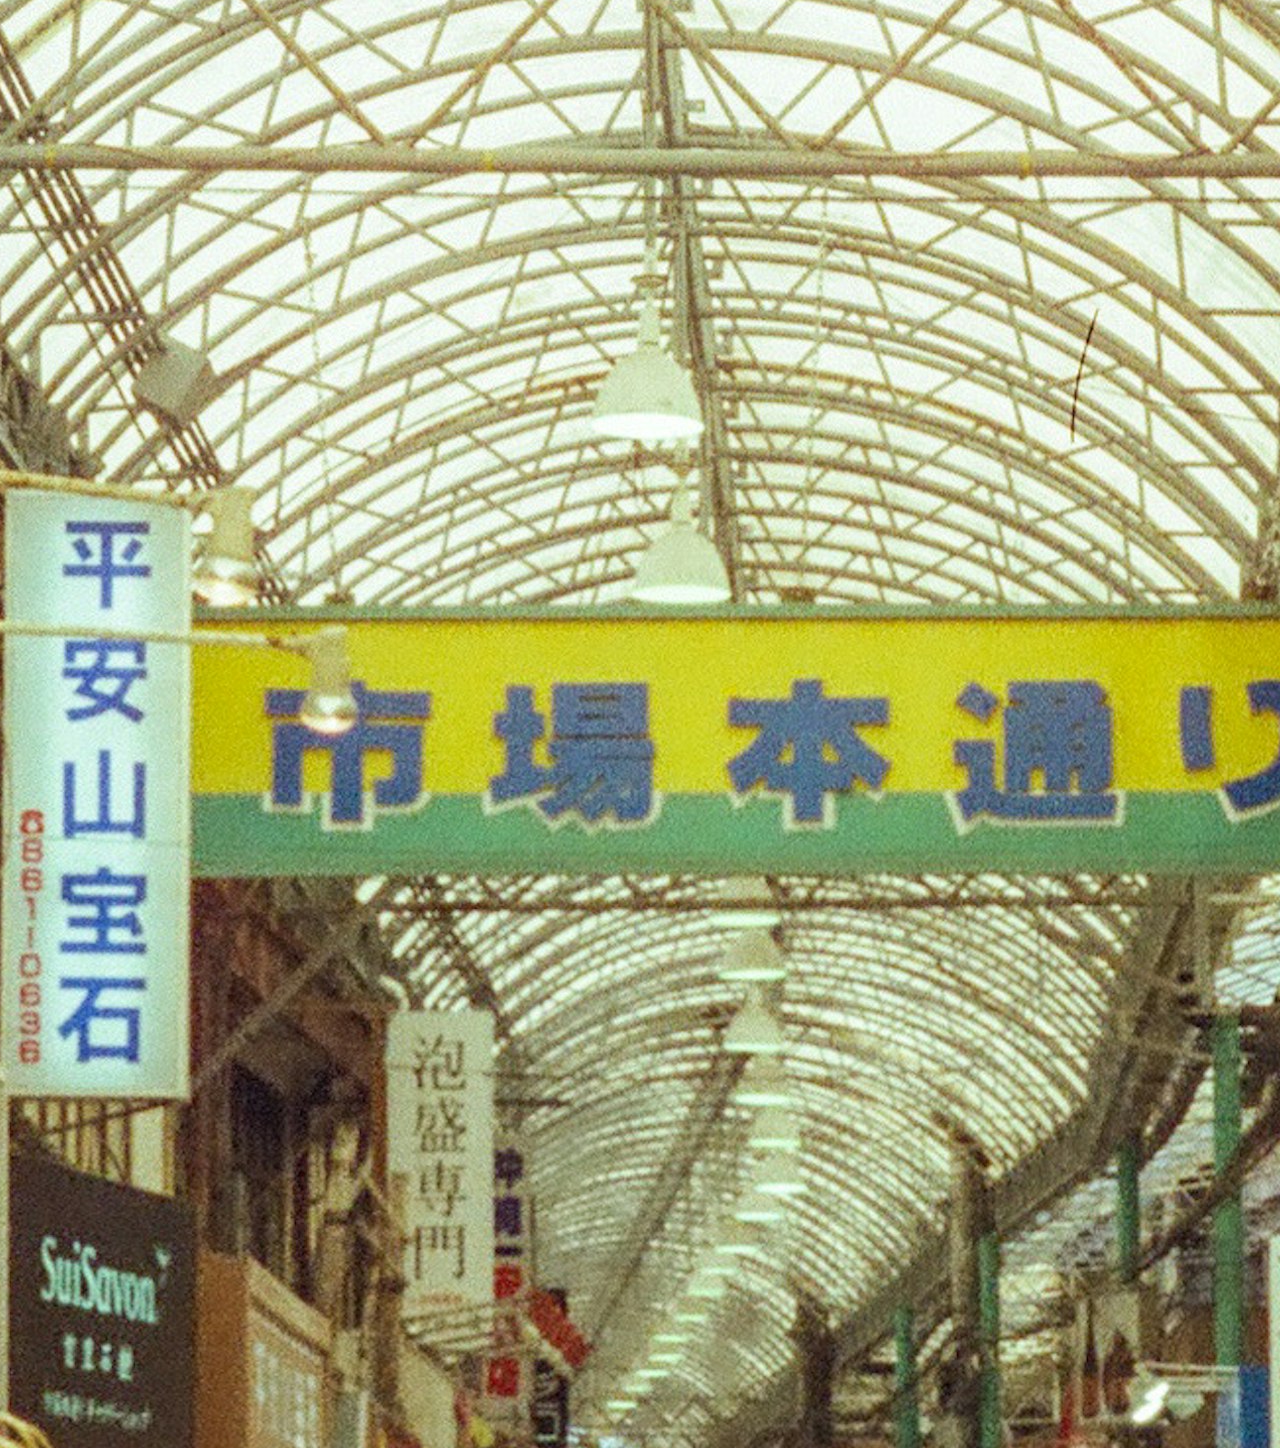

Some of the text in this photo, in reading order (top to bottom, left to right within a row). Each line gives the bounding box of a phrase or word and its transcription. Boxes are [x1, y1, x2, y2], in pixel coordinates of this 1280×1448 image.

[58, 520, 152, 1064] 平安山宝石
[40, 1235, 158, 1324] SuiSavon
